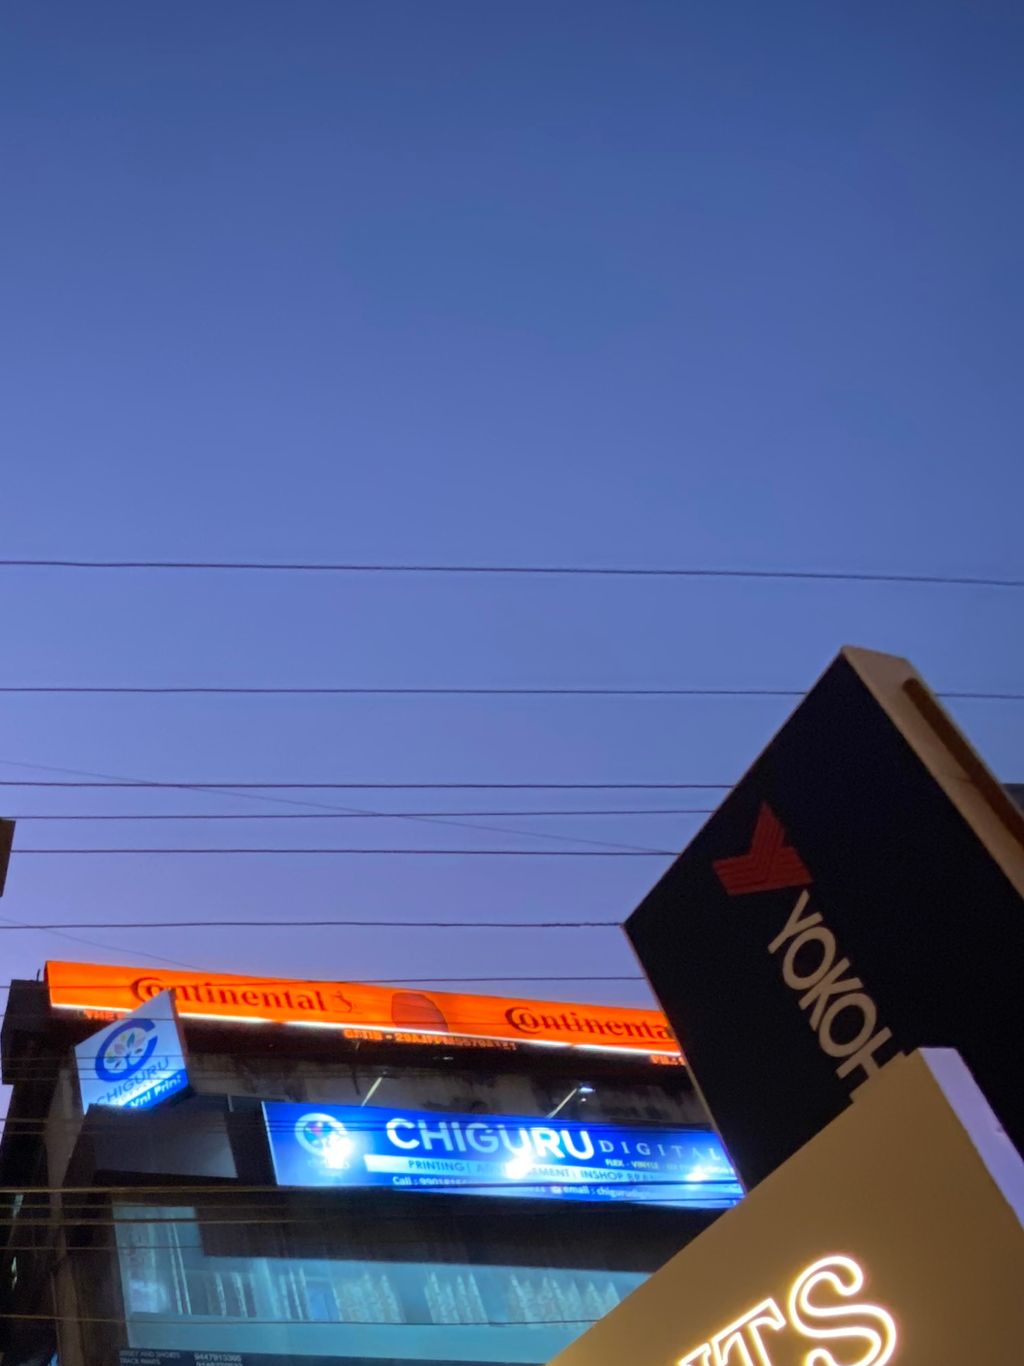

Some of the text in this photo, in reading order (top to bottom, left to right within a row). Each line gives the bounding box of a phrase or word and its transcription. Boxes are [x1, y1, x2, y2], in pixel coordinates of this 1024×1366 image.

[386, 1116, 595, 1161] CHIGURU
[598, 1139, 721, 1161] DIGITAL
[408, 1159, 465, 1172] PRINTING
[580, 1170, 625, 1182] INSHOP
